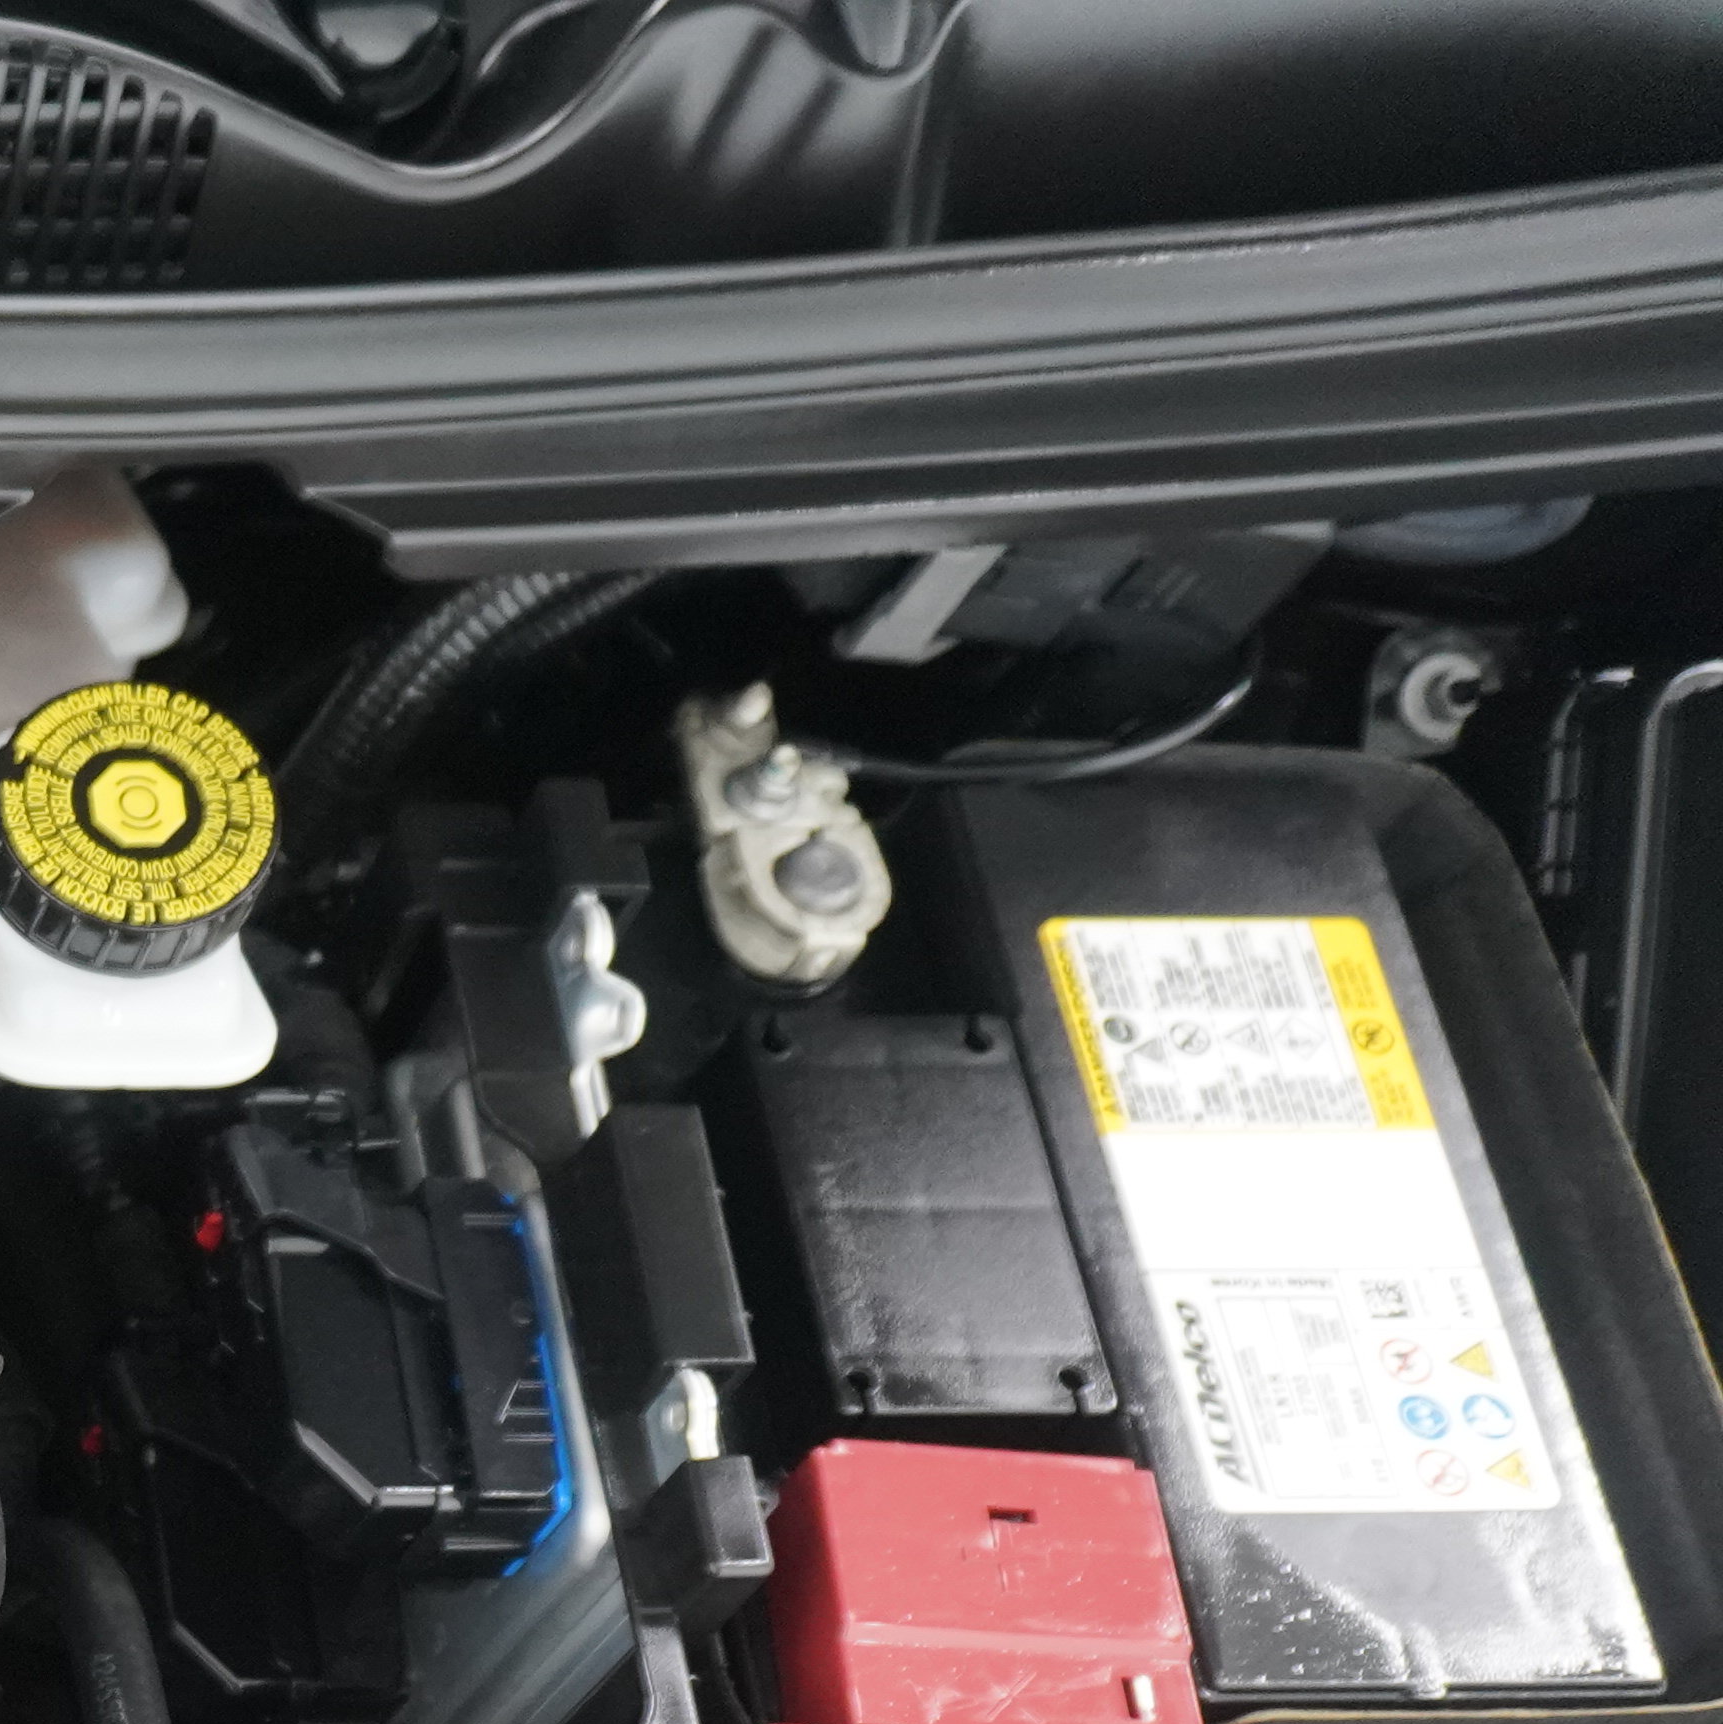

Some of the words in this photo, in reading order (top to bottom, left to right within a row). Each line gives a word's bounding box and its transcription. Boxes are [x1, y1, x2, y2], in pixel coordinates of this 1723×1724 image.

[107, 703, 140, 724] USE
[143, 705, 183, 731] ONLY
[176, 716, 209, 744] DOT
[205, 740, 244, 780] FLUID
[113, 683, 171, 707] FILLER
[170, 692, 212, 723] CAP
[204, 712, 260, 768] BEFORE
[56, 739, 94, 774] FROM
[86, 731, 104, 751] A
[98, 723, 151, 748] SEALED
[151, 728, 218, 779] CONTAINER
[202, 777, 226, 800] DOT
[227, 780, 252, 824] AVANT
[2, 780, 44, 866] REMPLISSAGE
[171, 812, 228, 873] PROVENANT
[222, 829, 248, 849] DE
[30, 856, 61, 884] DE
[59, 823, 137, 879] CONTENANT
[141, 855, 178, 883] D'UN
[51, 874, 126, 920] BOUCHON
[133, 901, 156, 924] LE
